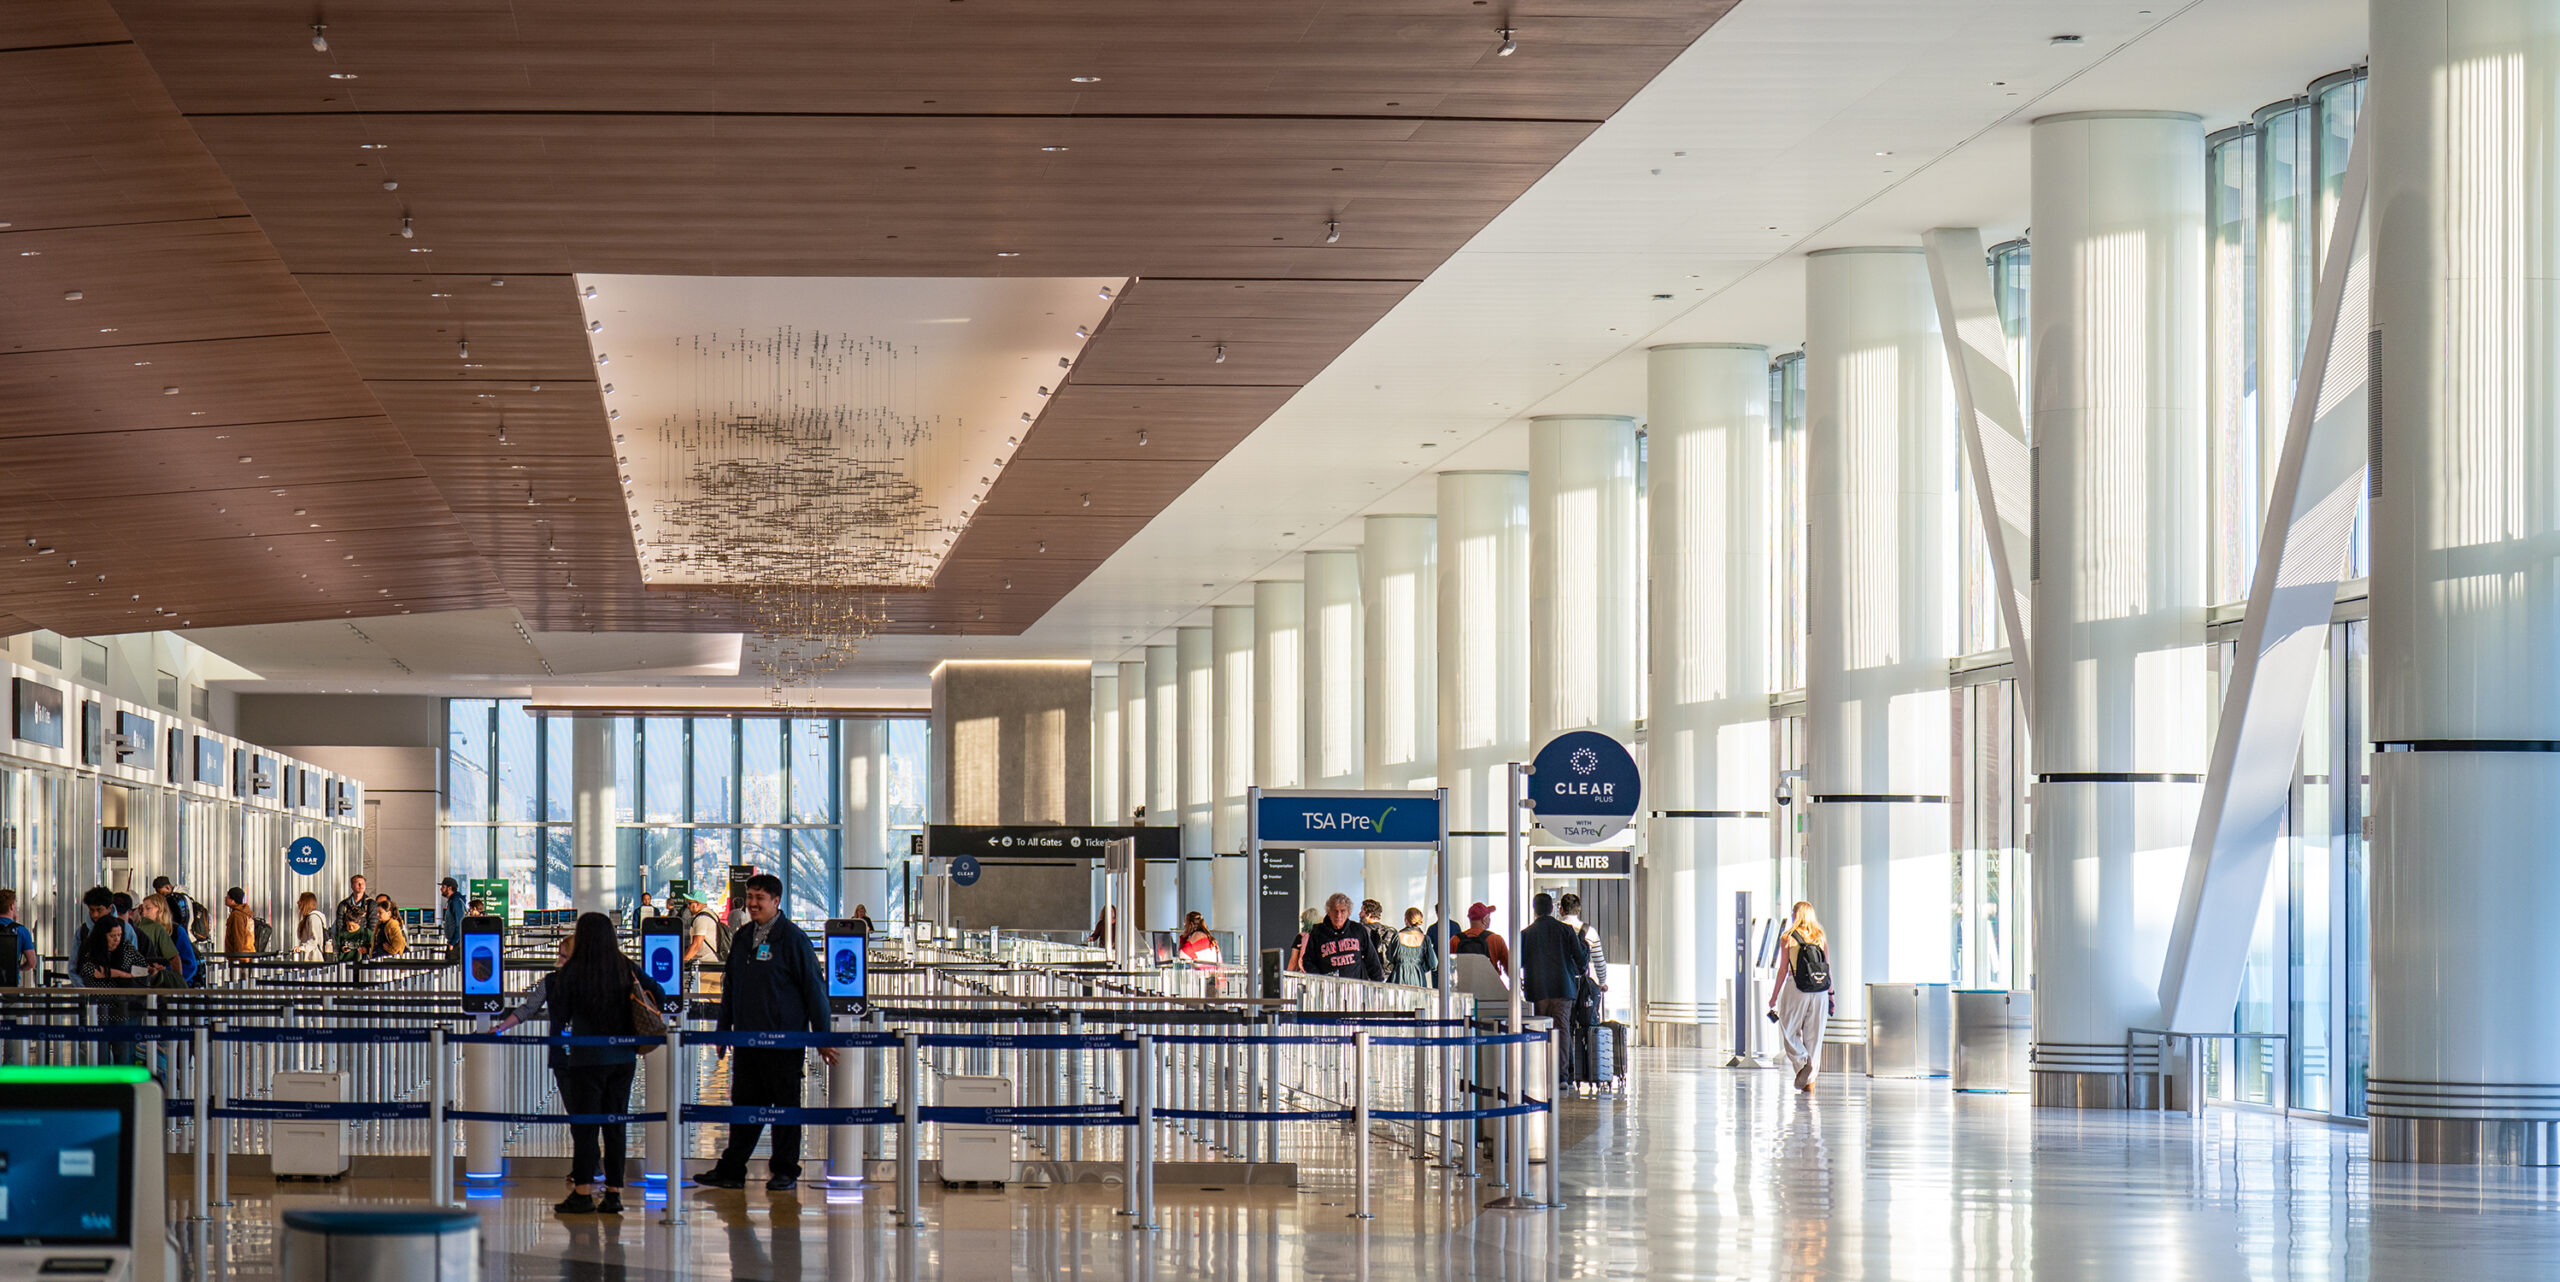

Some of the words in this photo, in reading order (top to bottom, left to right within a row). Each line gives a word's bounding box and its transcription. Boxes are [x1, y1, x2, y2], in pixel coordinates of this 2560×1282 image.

[1555, 783, 1614, 795] CLEAR
[1302, 813, 1336, 829] TSA
[1341, 813, 1370, 829] Pre
[1564, 827, 1580, 835] TSA
[1581, 827, 1596, 835] Pre
[1016, 838, 1025, 846] To
[1028, 838, 1038, 846] All
[1040, 838, 1062, 846] Gates
[1554, 856, 1573, 869] ALL
[1576, 856, 1609, 869] GATES
[1321, 941, 1336, 958] SAN
[1330, 954, 1356, 966] STATE
